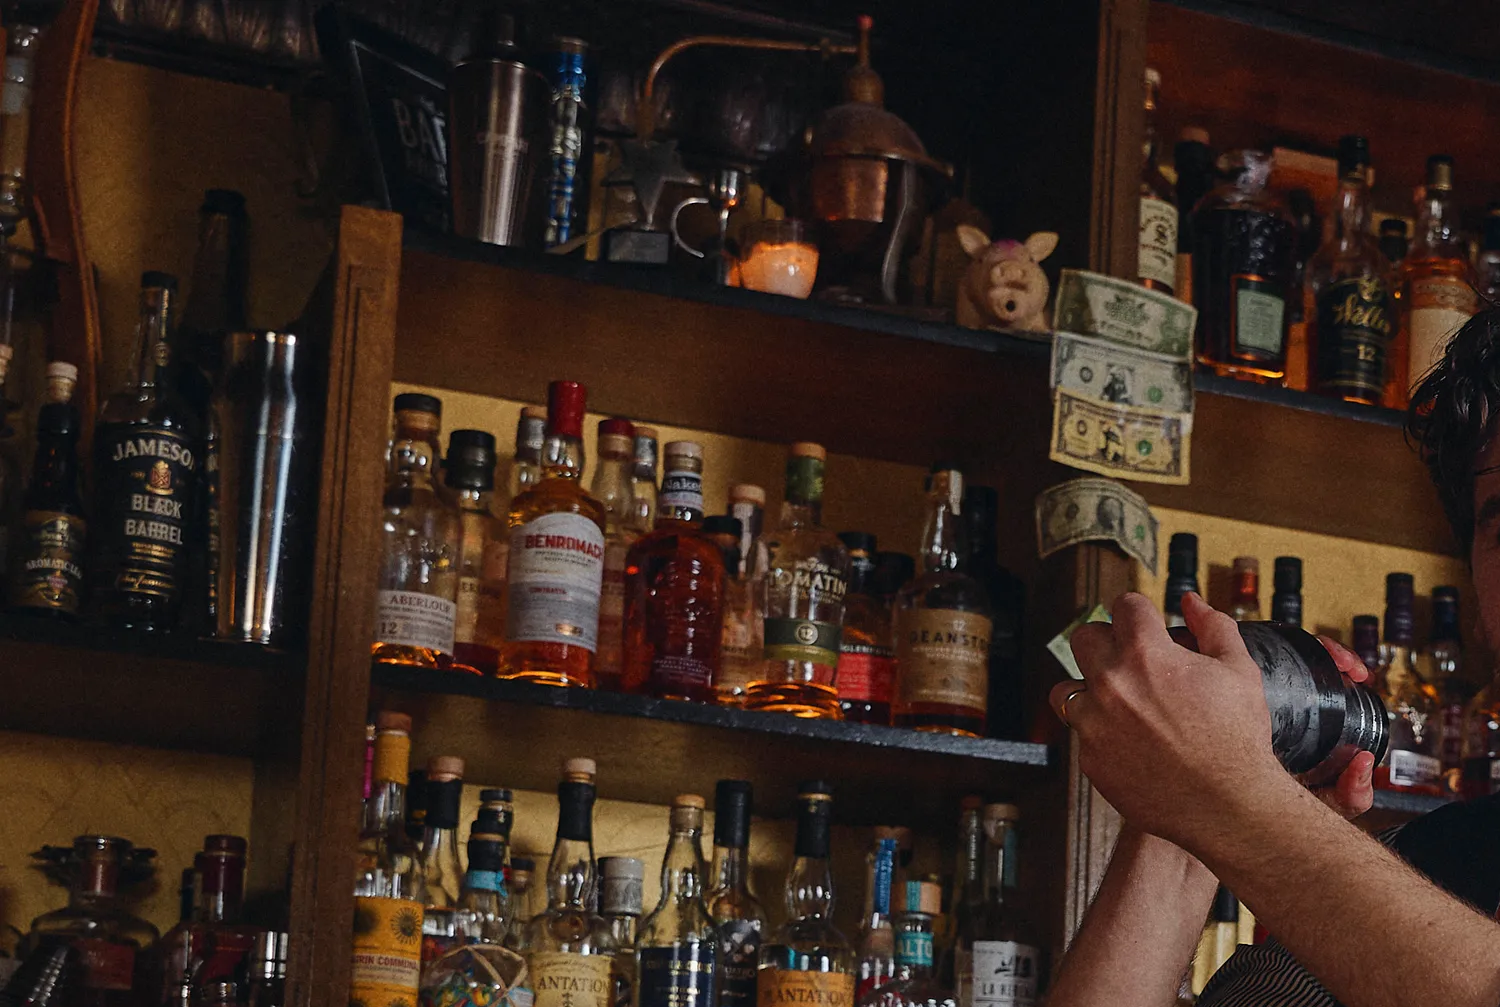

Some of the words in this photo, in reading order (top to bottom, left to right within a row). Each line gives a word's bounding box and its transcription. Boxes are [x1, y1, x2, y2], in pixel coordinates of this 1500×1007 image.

[131, 493, 183, 519] BLACK
[125, 518, 184, 546] BARREL
[766, 570, 847, 595] TOMATIN
[380, 621, 397, 635] 12
